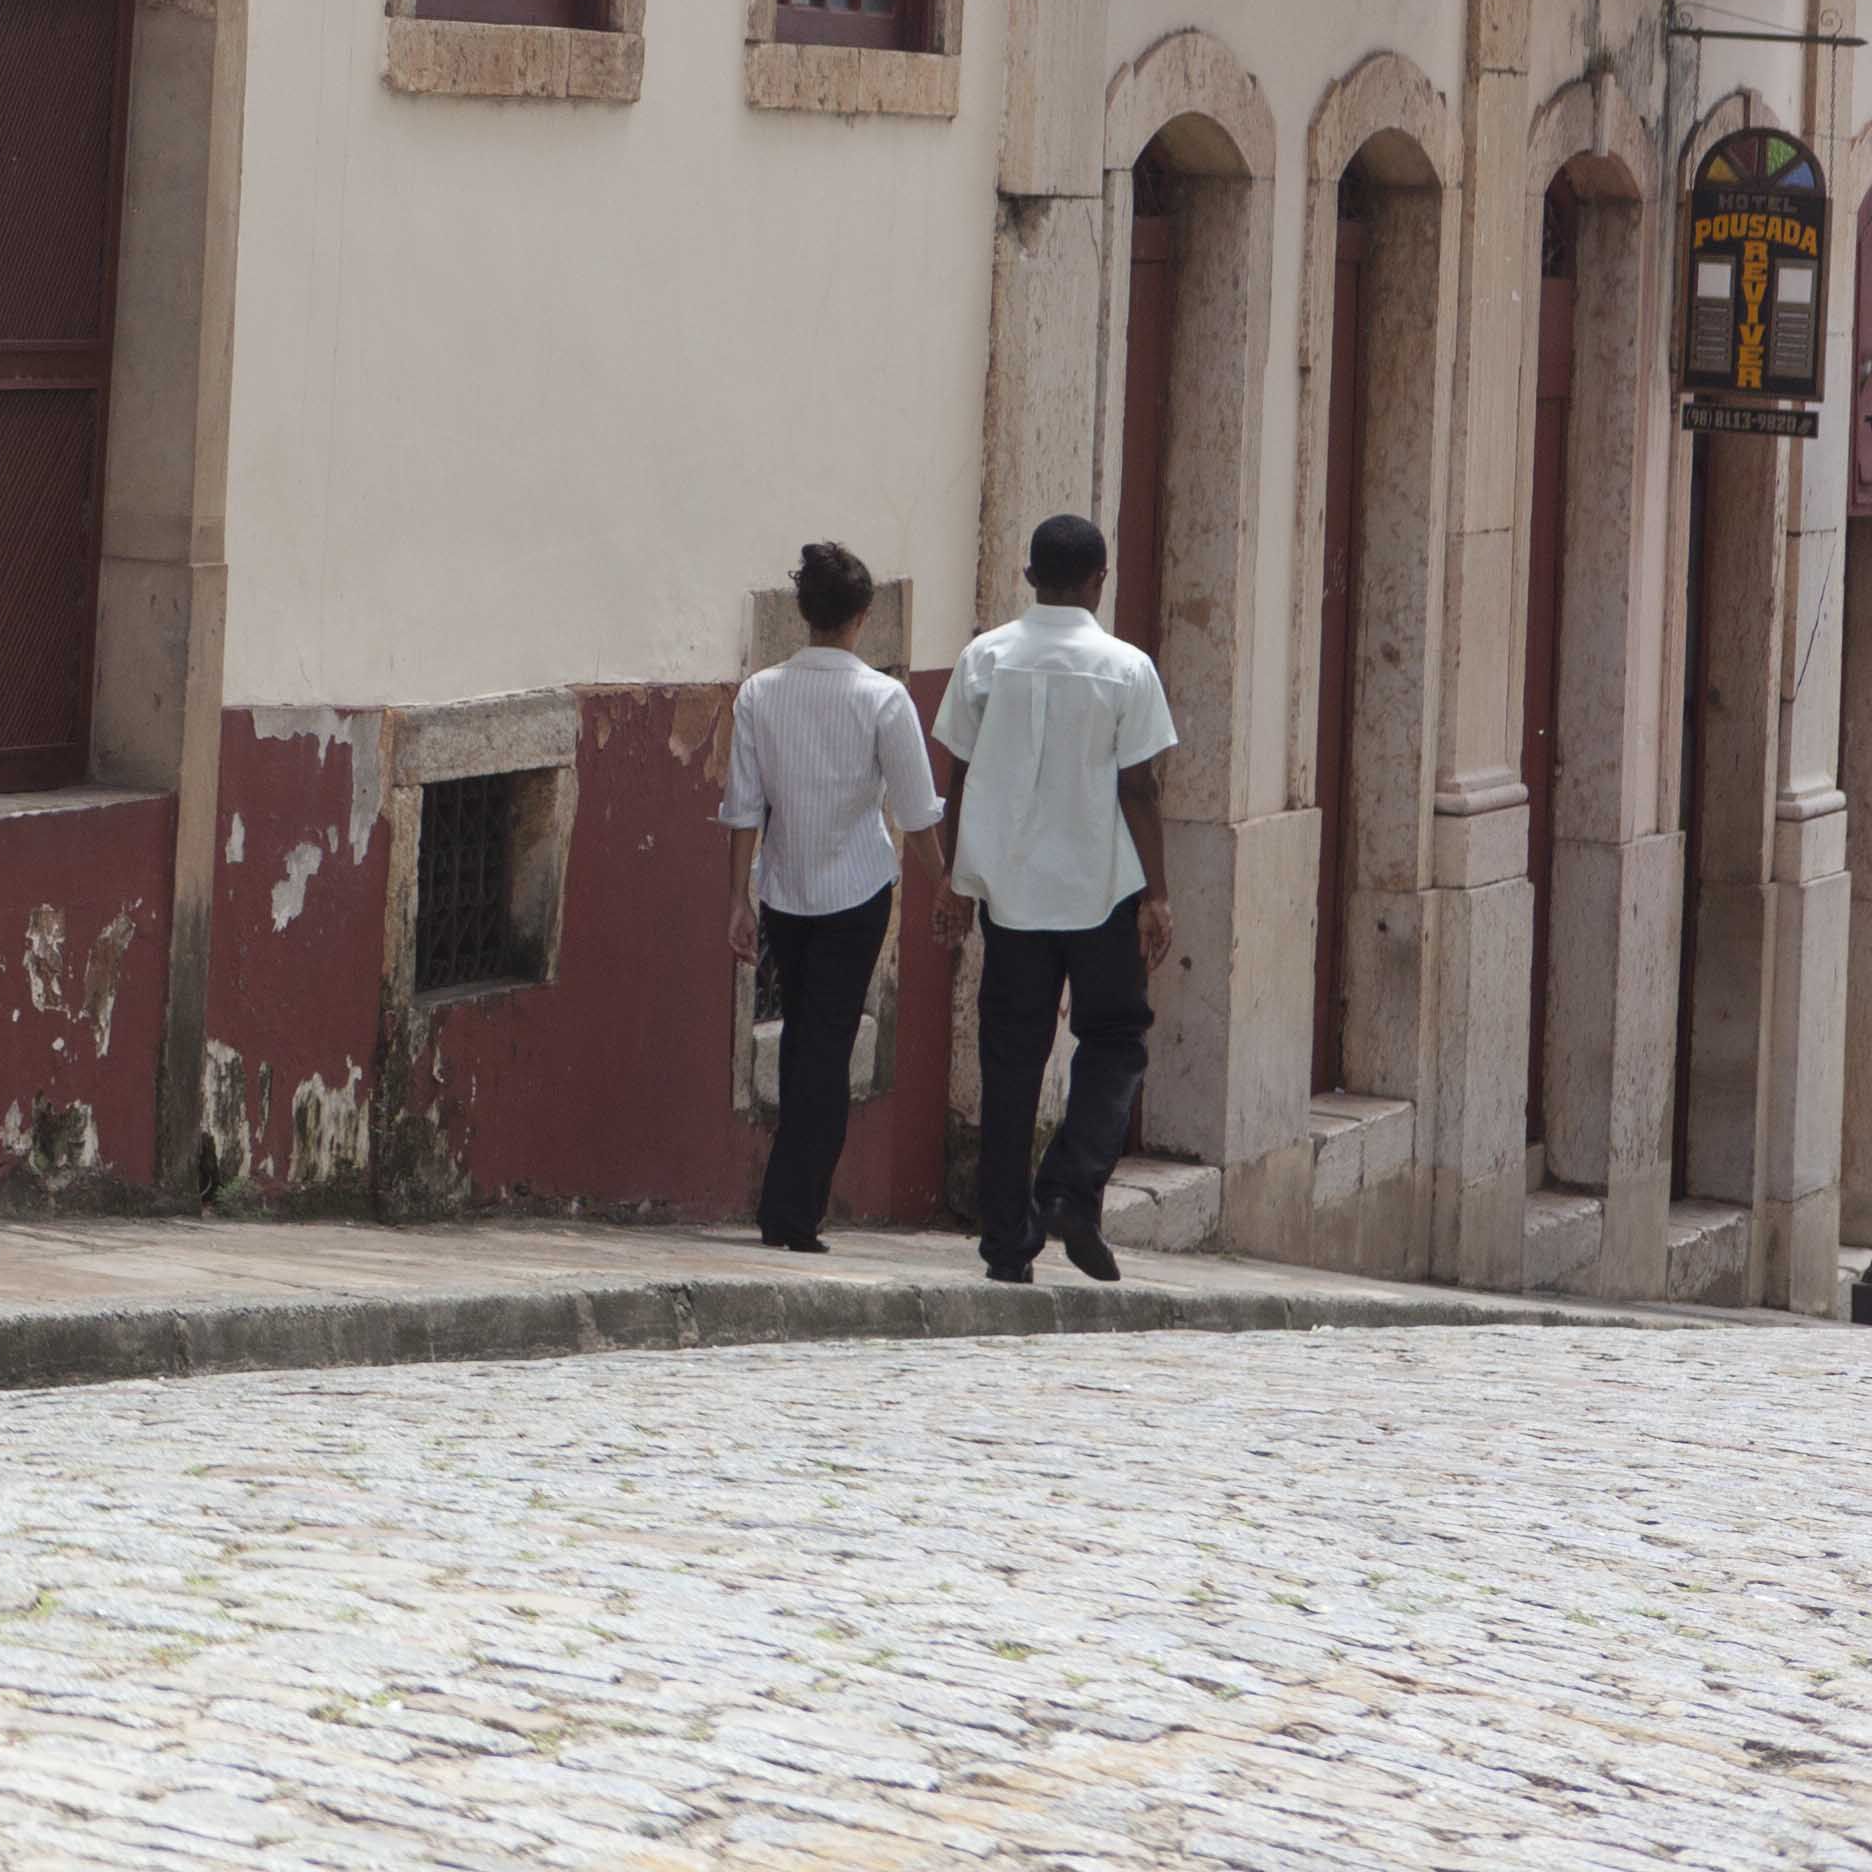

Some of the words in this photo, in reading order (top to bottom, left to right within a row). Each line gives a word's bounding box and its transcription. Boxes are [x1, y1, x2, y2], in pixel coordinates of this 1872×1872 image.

[1718, 192, 1799, 213] HOTEL
[1694, 212, 1818, 257] POUSADA
[1737, 239, 1769, 389] REVIVER
